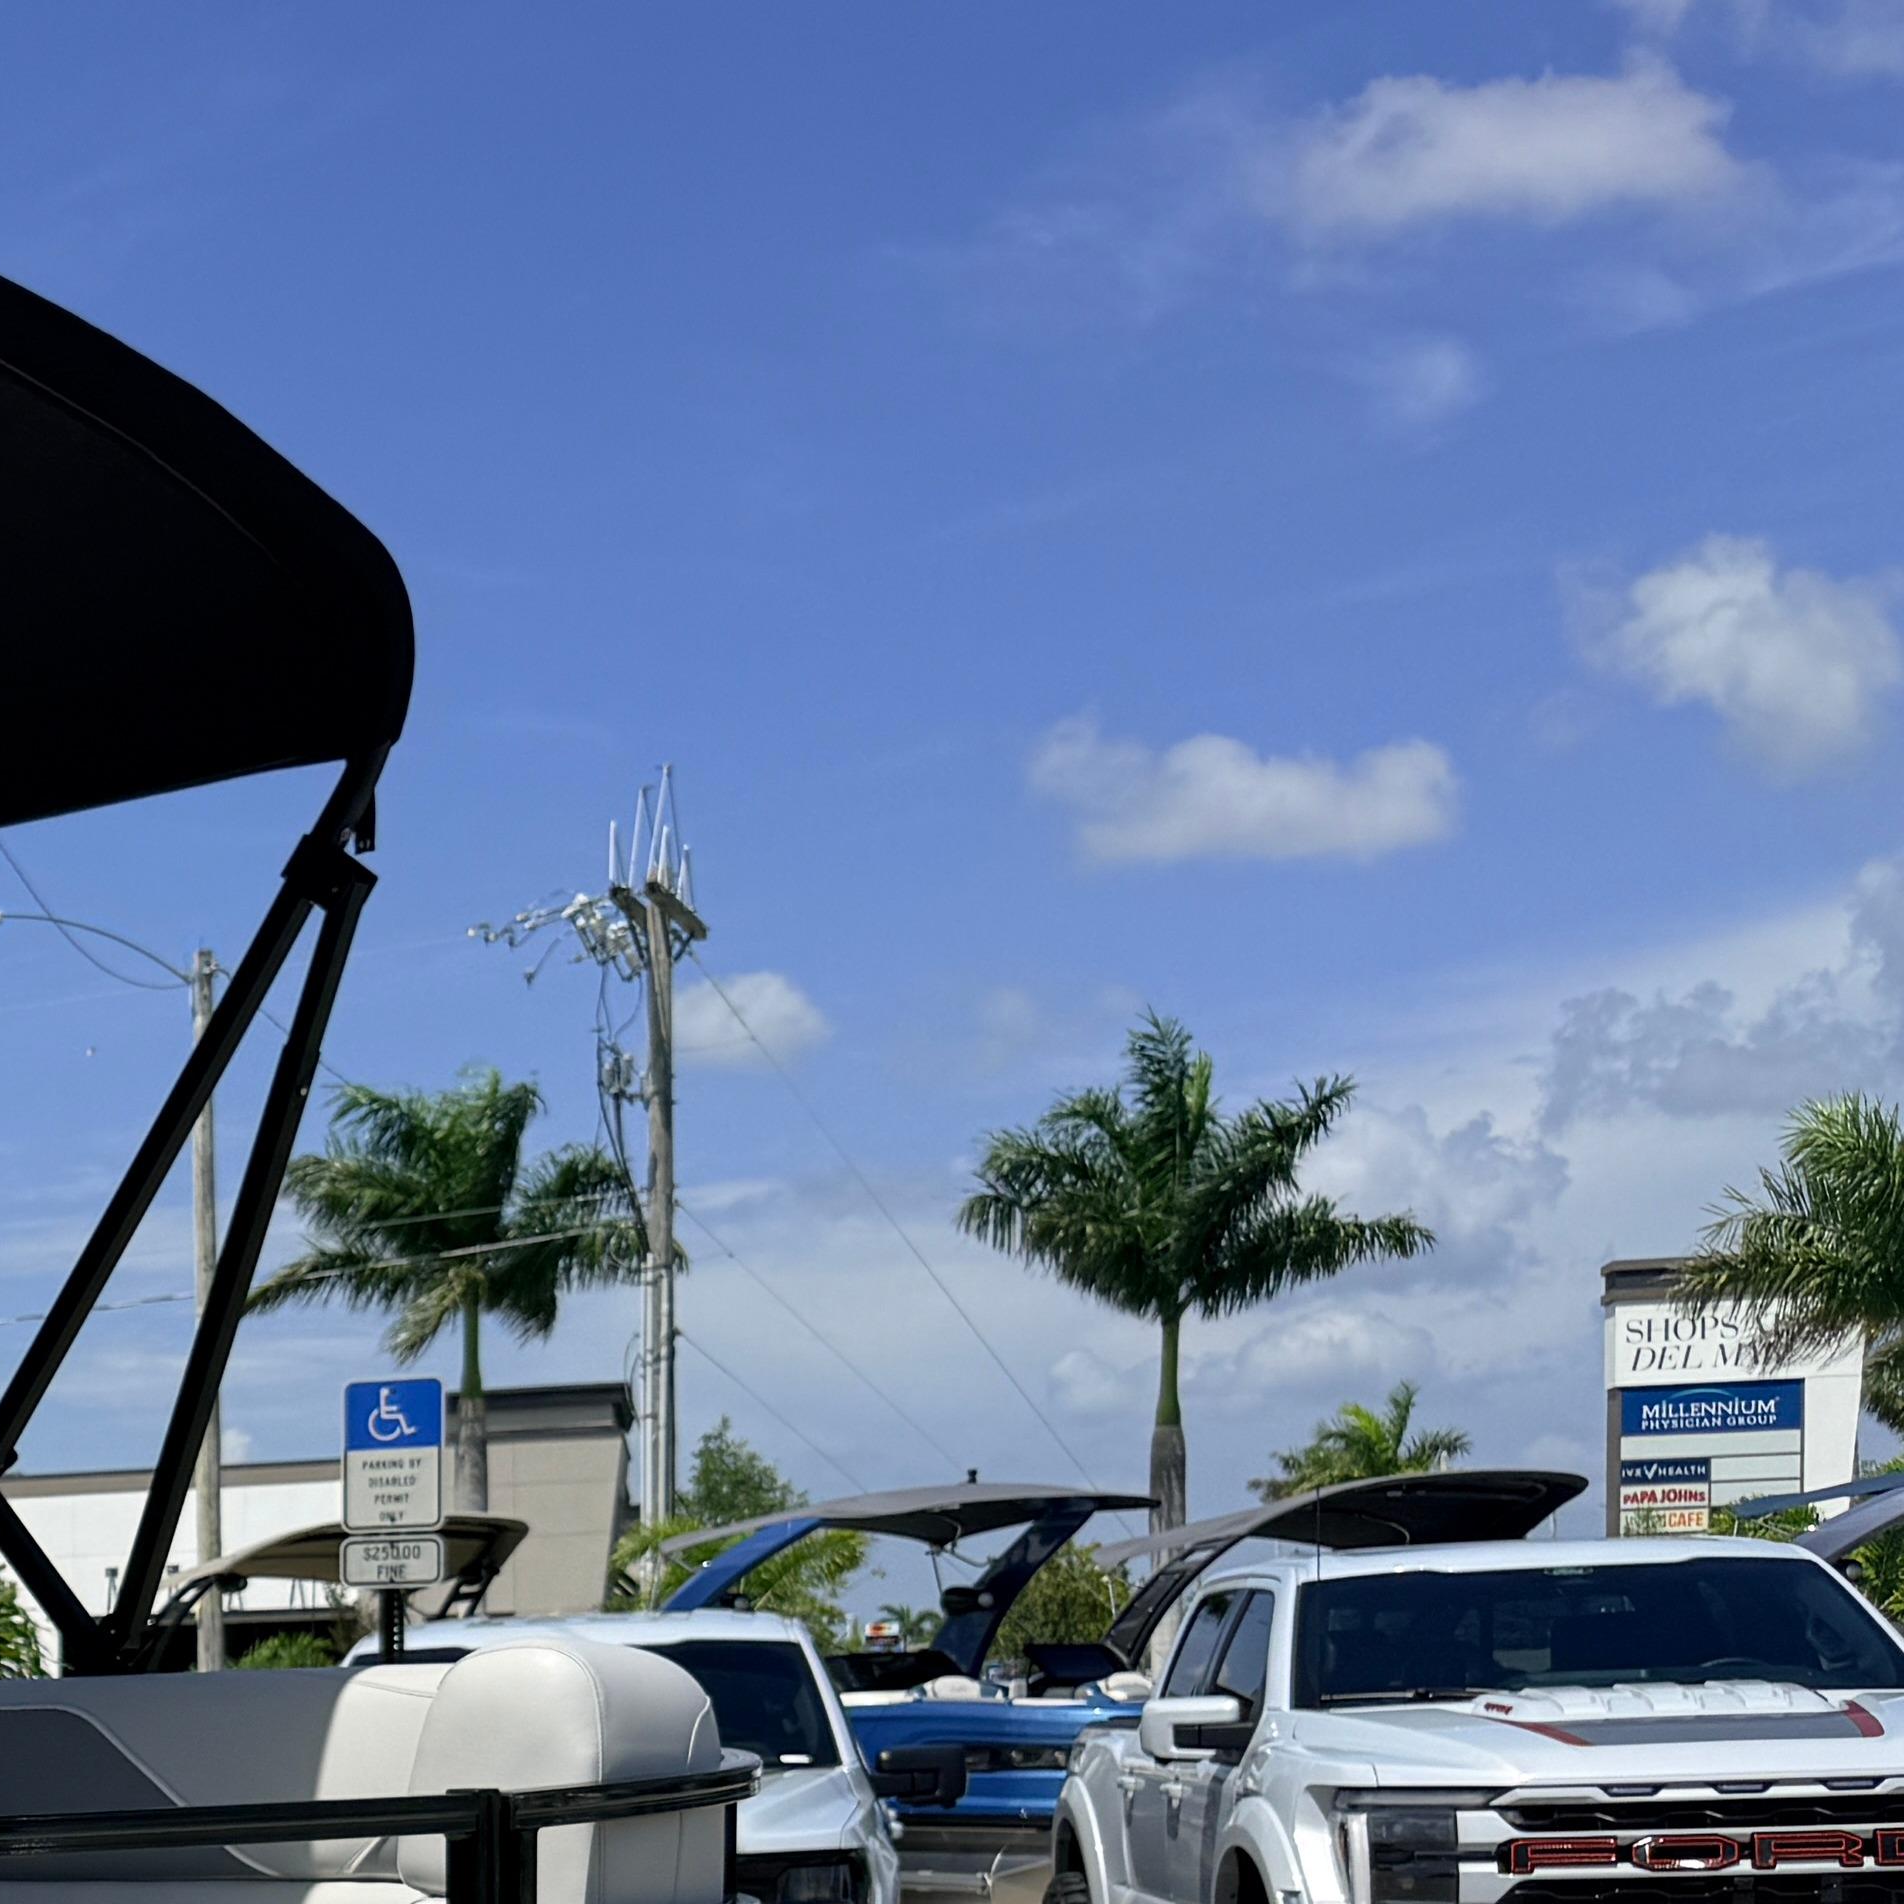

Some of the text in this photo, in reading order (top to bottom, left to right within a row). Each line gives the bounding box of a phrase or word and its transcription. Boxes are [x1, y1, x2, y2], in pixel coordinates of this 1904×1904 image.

[1626, 1314, 1739, 1344] SHOPS
[1632, 1345, 1702, 1372] DEL
[1642, 1414, 1777, 1430] PHYSICIAN GROUP
[362, 1458, 421, 1471] PARKING BY
[368, 1475, 416, 1487] DISABLED
[374, 1493, 409, 1504] PERMIT
[1623, 1490, 1658, 1505] PAPA
[1669, 1511, 1704, 1528] CAFE
[377, 1565, 406, 1579] FINE
